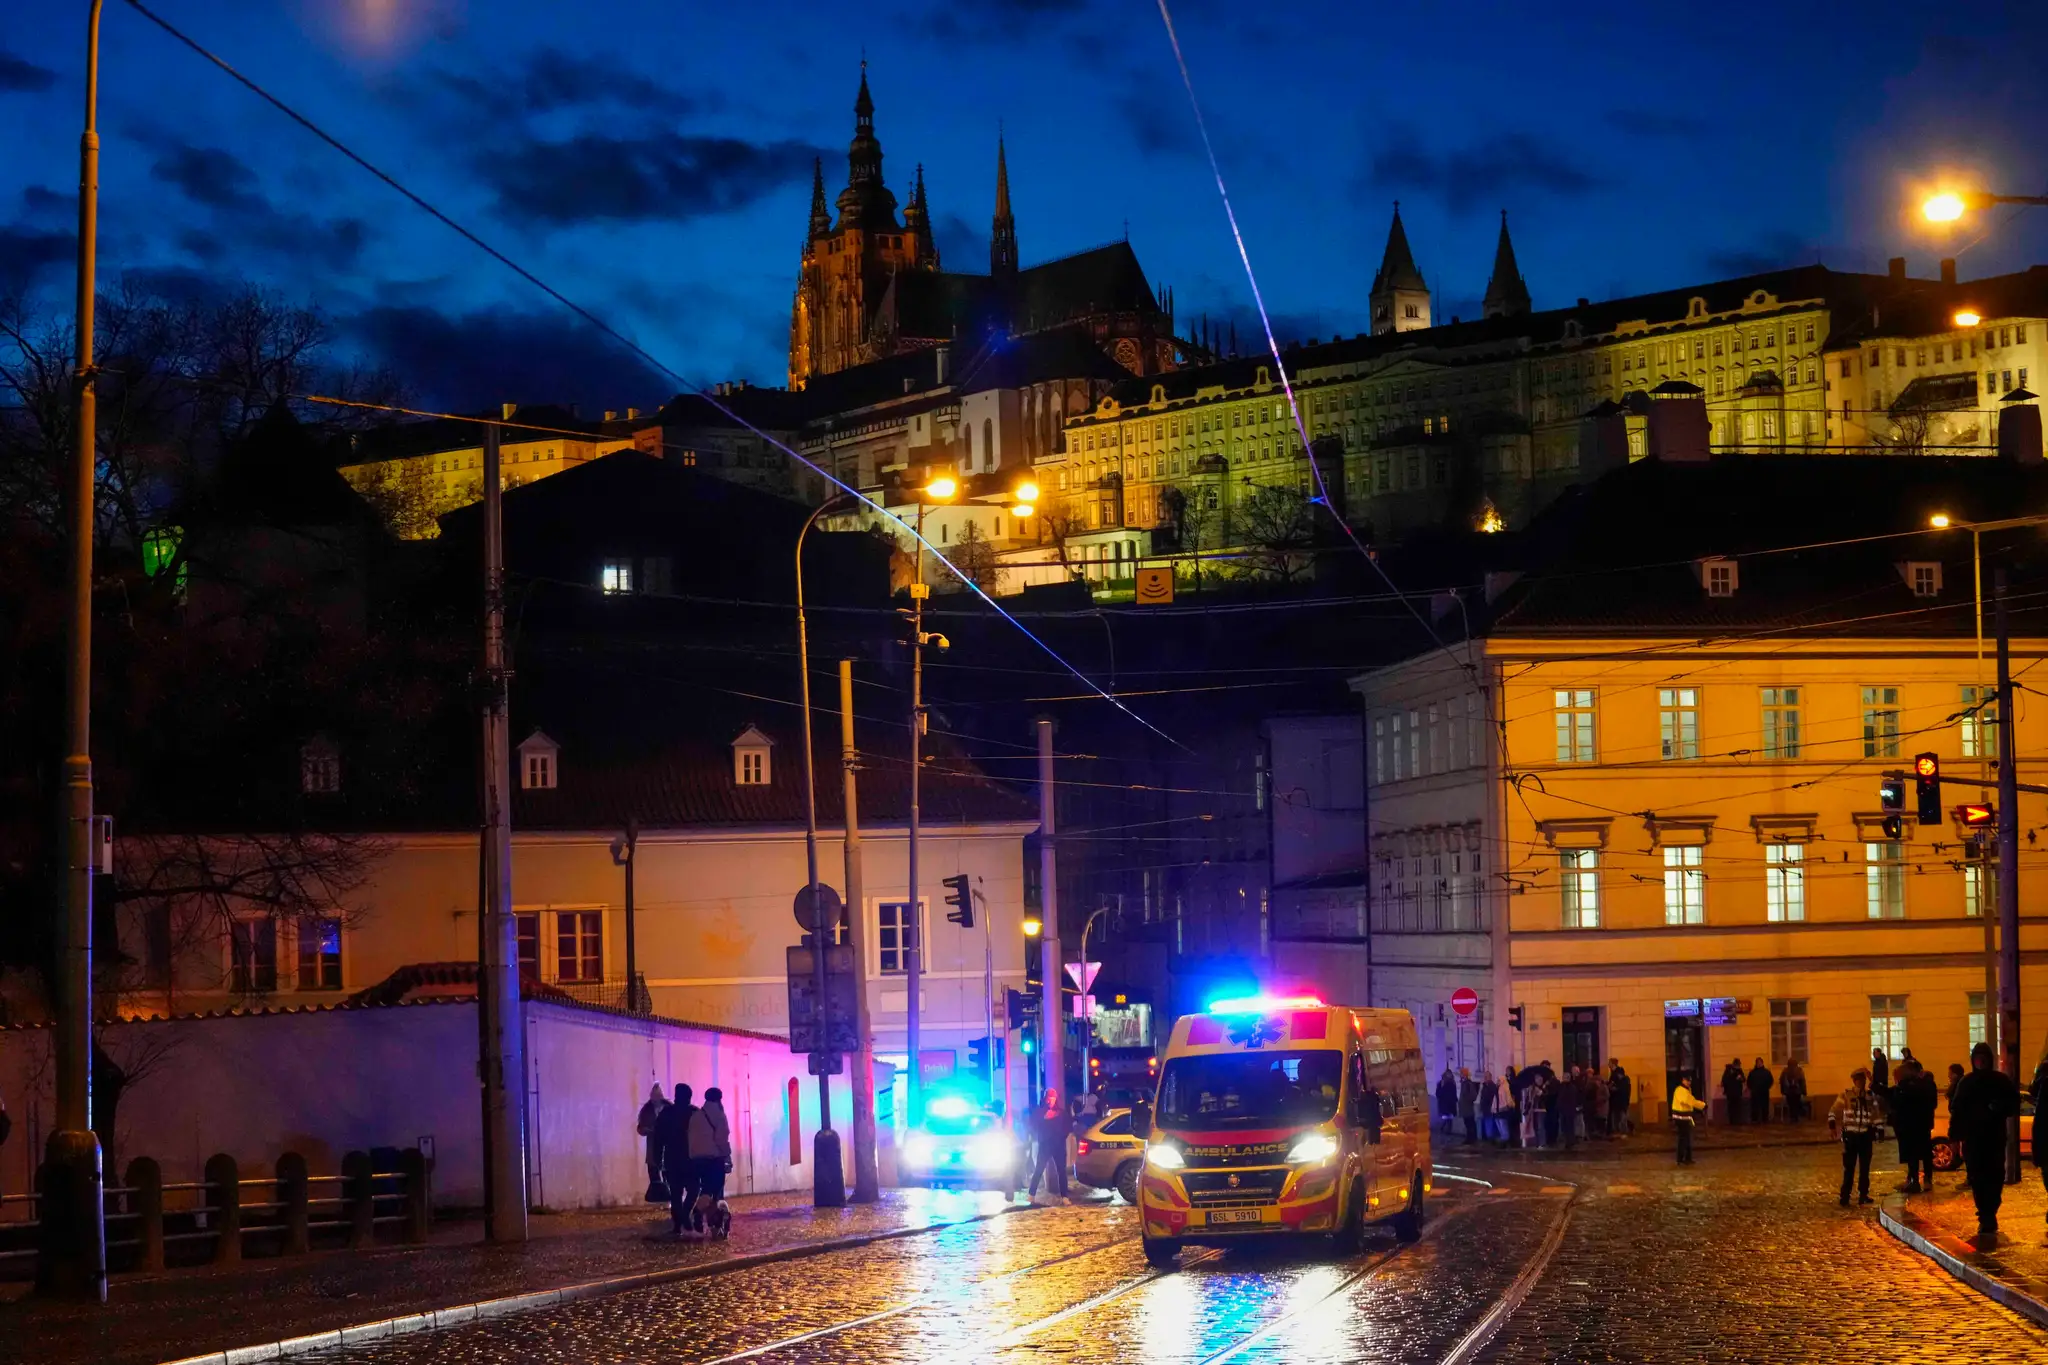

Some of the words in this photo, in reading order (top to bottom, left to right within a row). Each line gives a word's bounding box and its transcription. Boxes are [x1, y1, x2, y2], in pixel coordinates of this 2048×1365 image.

[1183, 1143, 1289, 1157] AMBULANCE
[1212, 1211, 1229, 1222] 6SL
[1235, 1210, 1257, 1222] 5910
